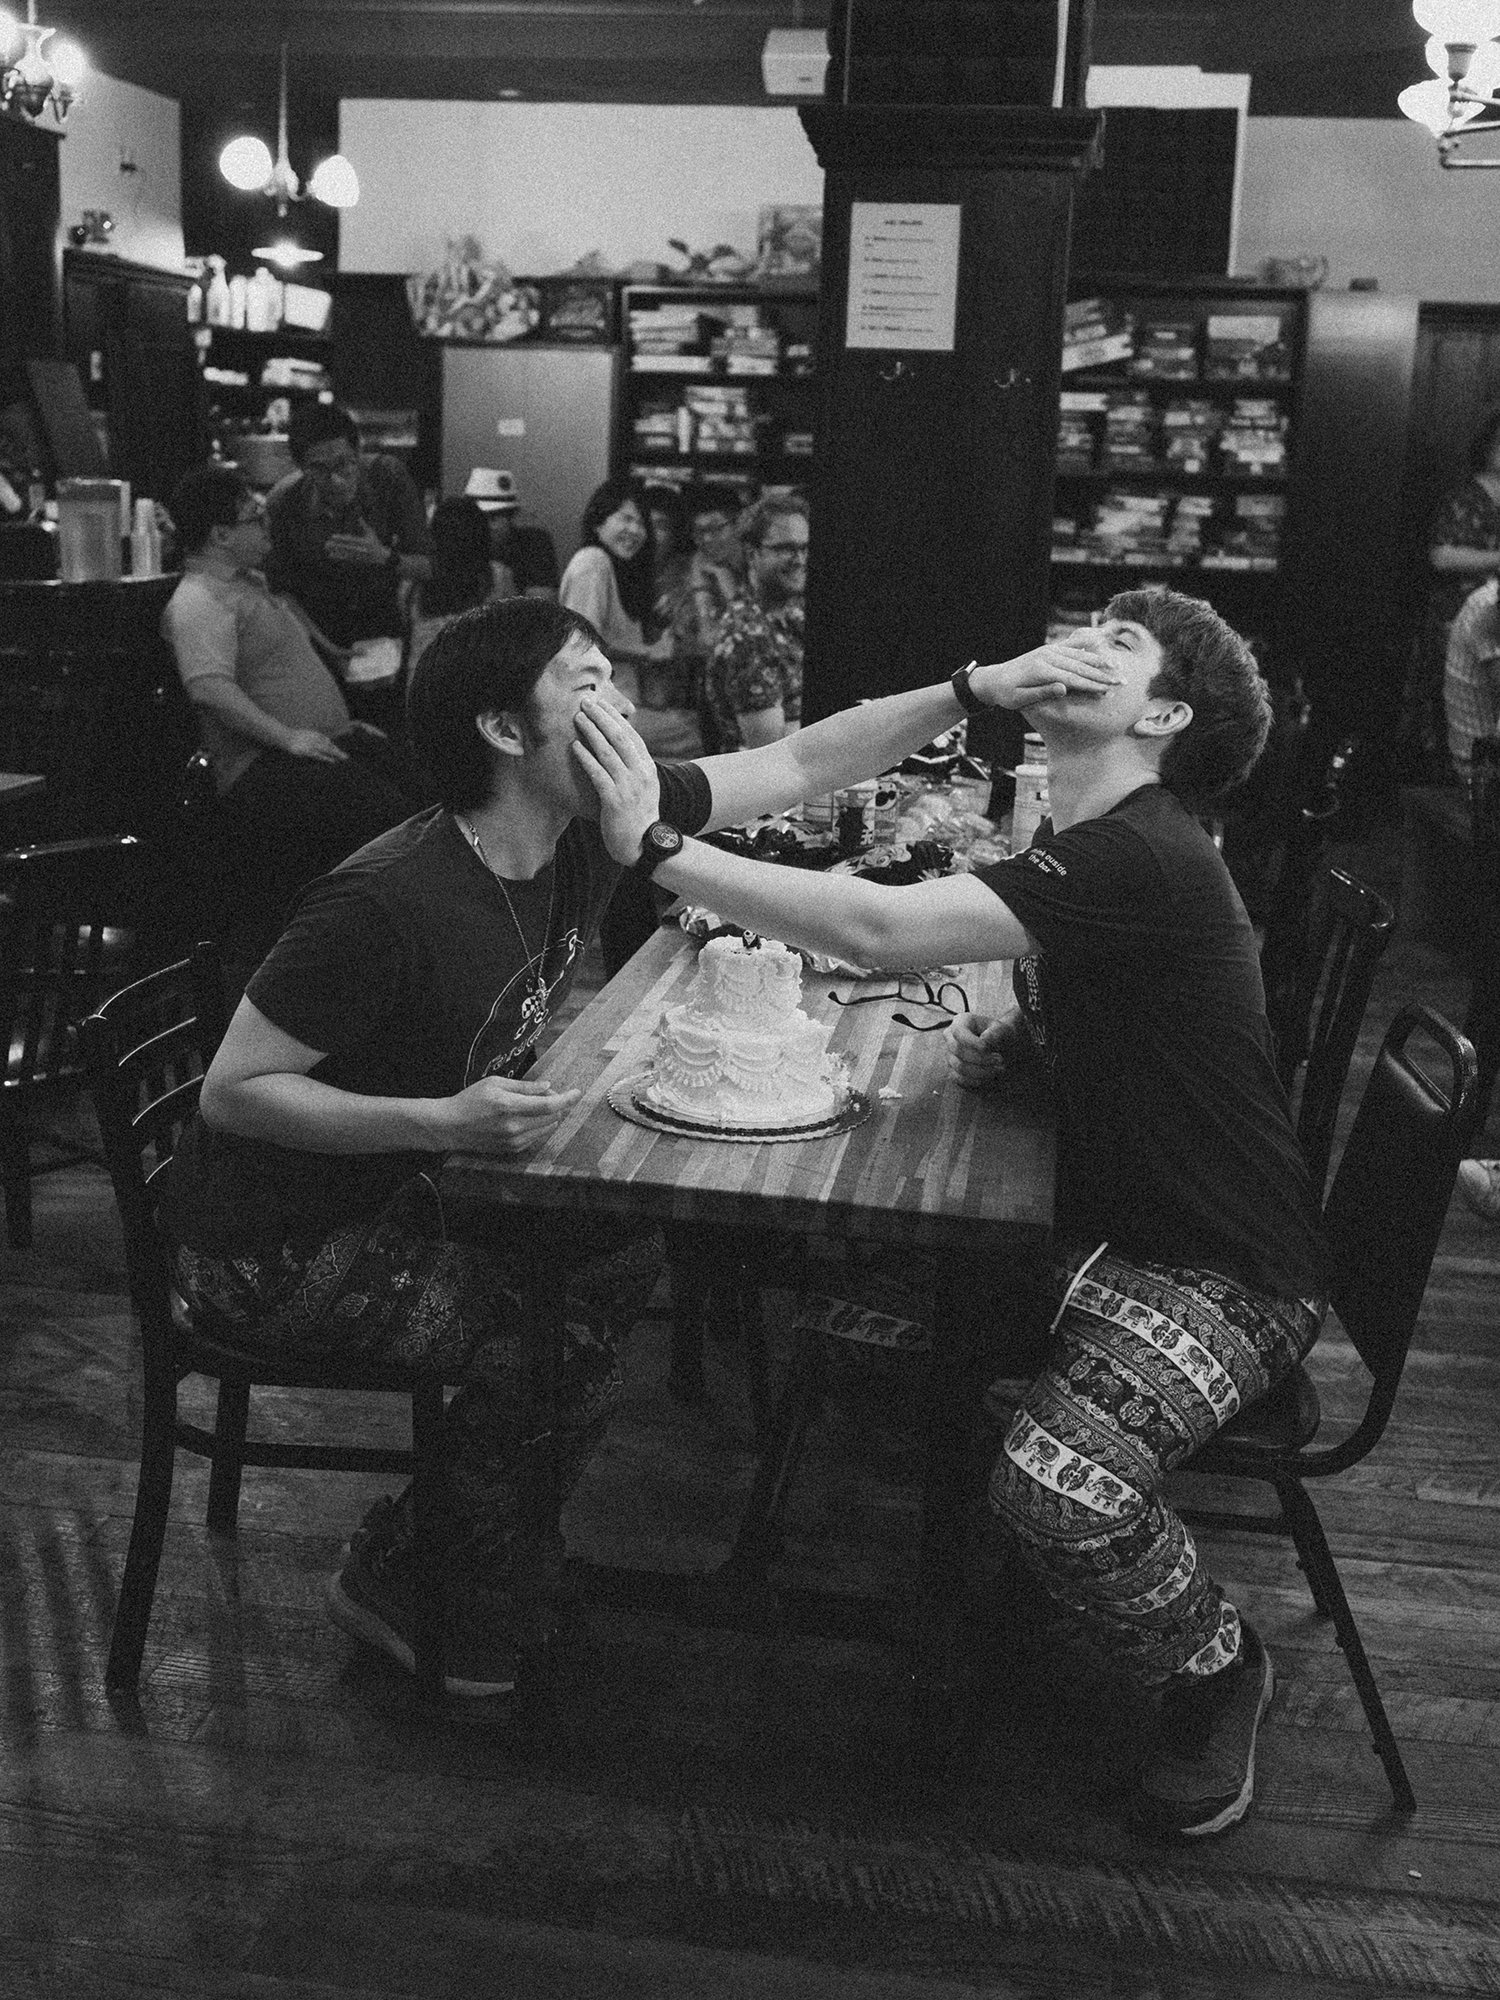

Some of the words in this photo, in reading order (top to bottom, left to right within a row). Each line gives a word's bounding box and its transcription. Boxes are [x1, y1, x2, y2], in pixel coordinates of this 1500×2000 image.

[1028, 854, 1040, 864] the
[1038, 861, 1051, 873] box
[1045, 854, 1067, 876] ouside
